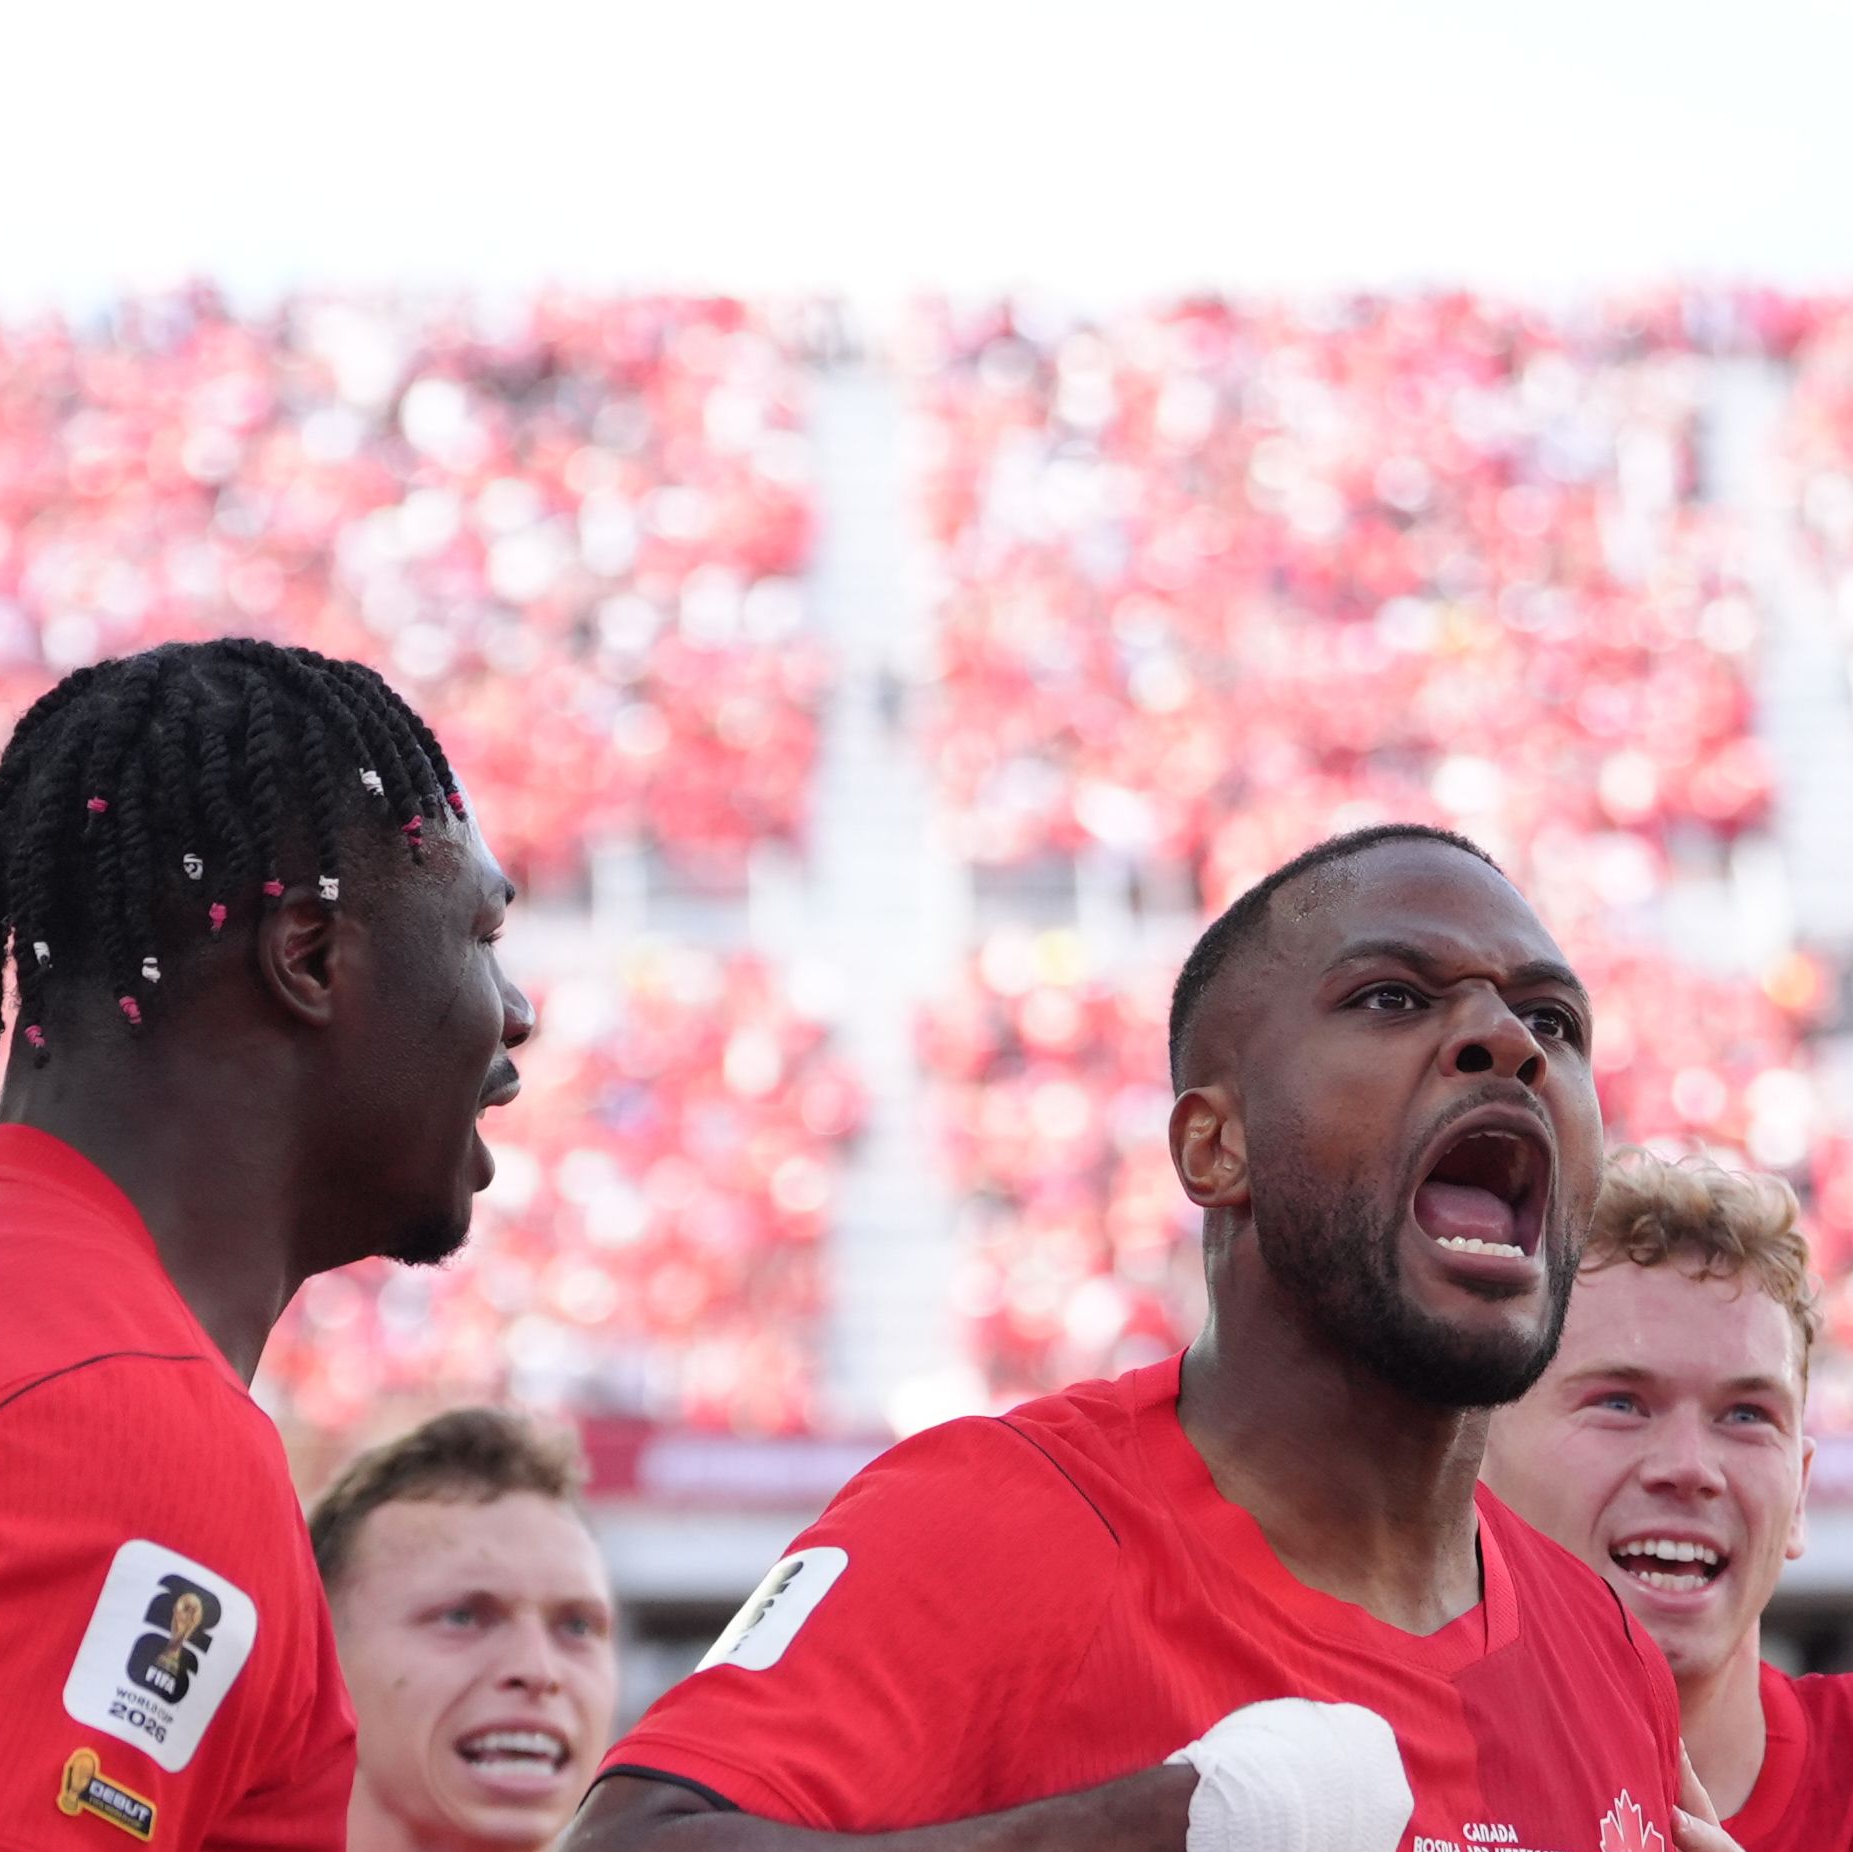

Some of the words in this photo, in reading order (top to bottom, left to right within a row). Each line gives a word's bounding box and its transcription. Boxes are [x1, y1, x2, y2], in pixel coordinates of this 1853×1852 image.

[145, 1664, 177, 1696] FIFA
[108, 1701, 167, 1744] 2026
[89, 1779, 152, 1821] DEBUT
[1463, 1822, 1518, 1843] CANADA
